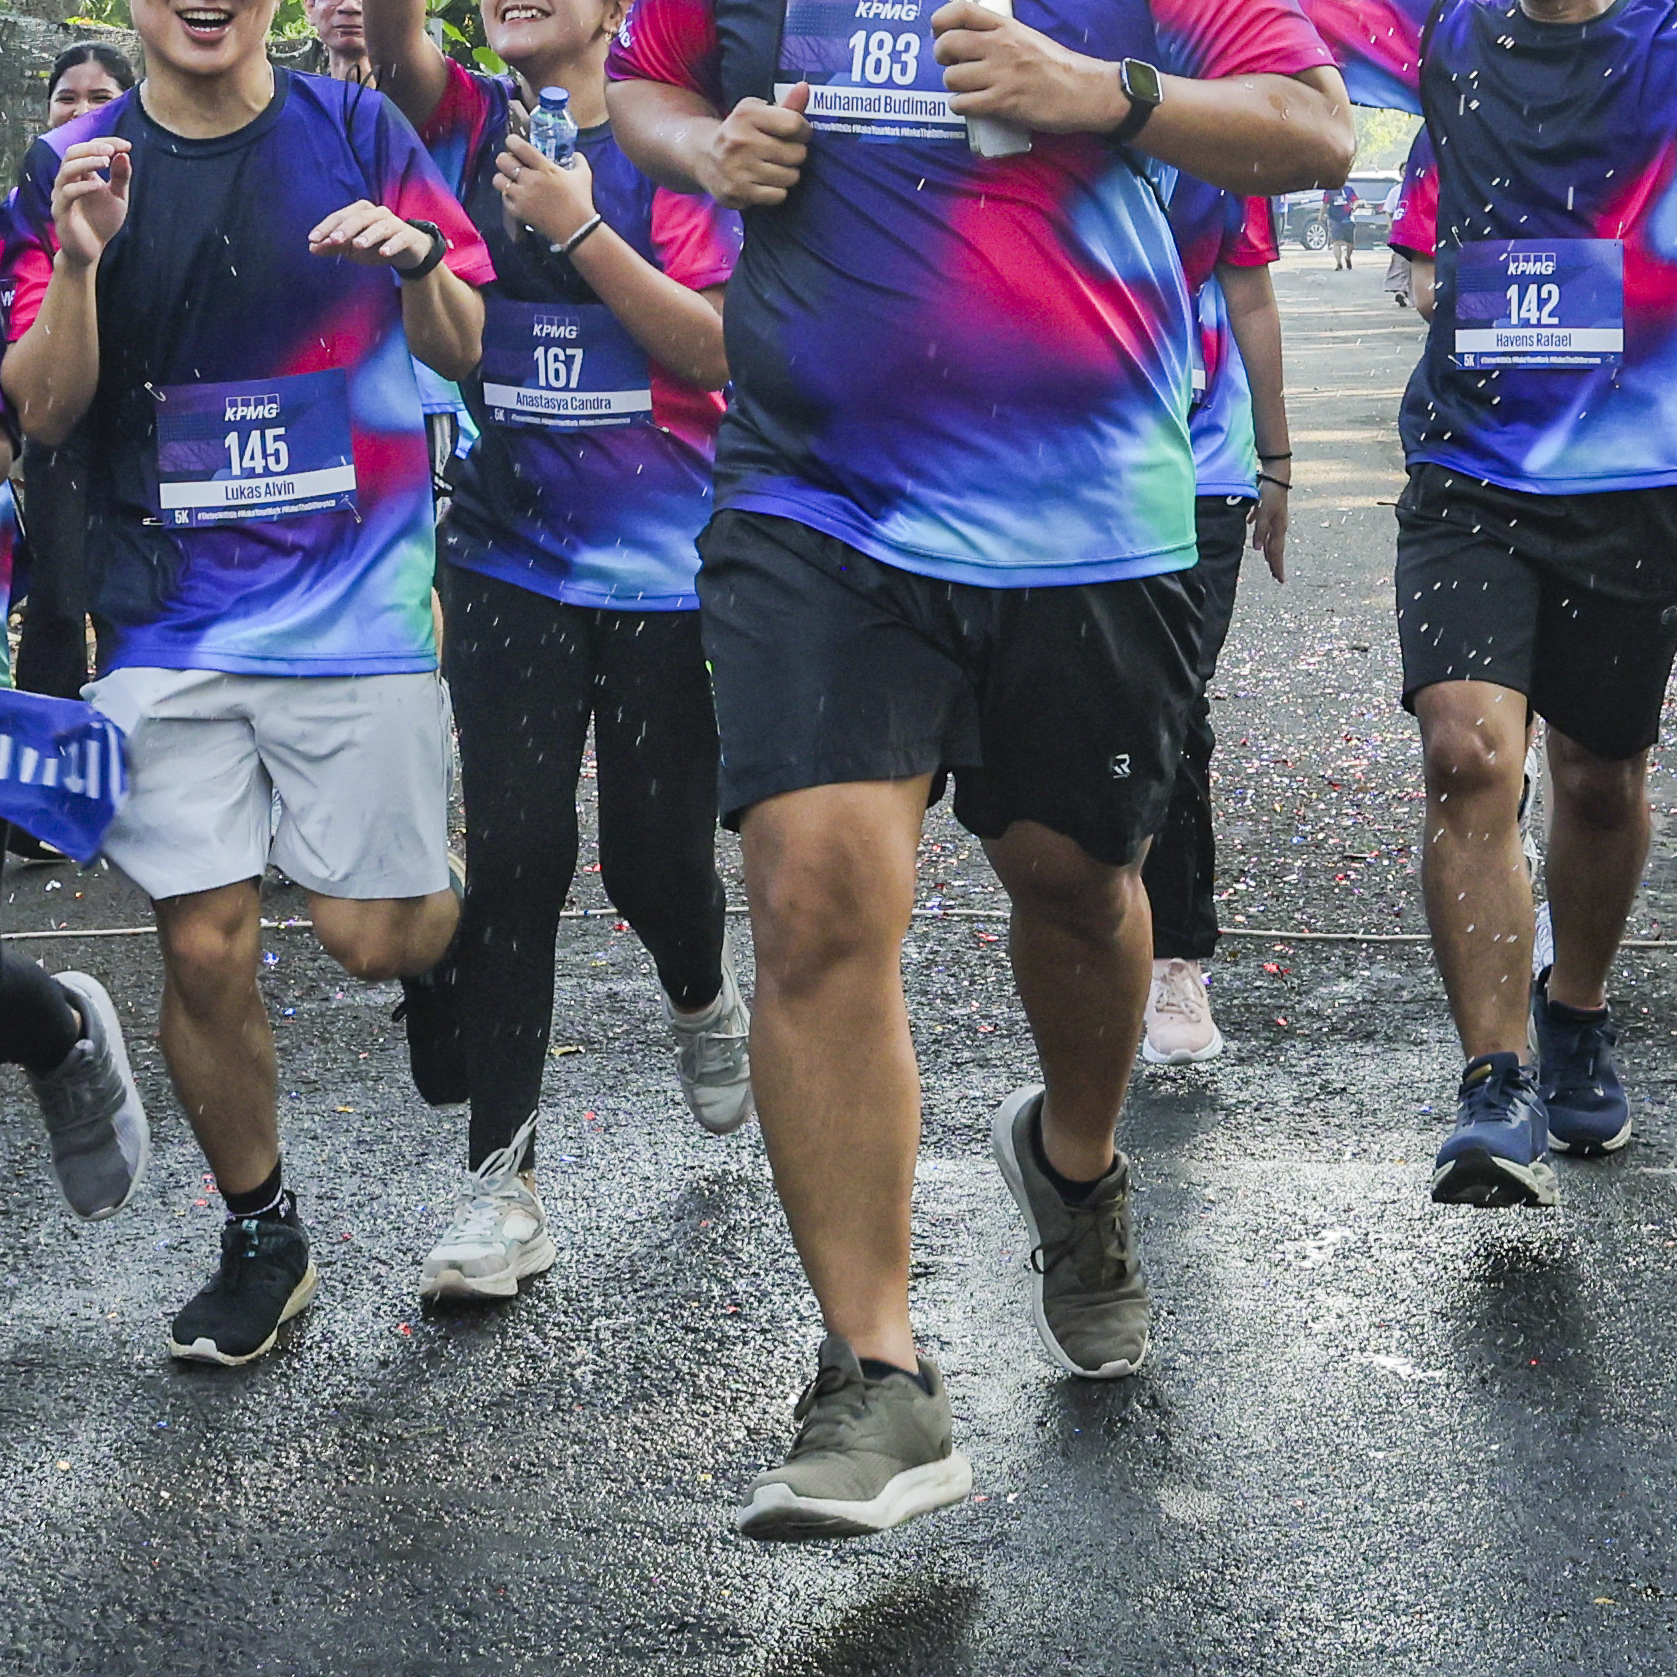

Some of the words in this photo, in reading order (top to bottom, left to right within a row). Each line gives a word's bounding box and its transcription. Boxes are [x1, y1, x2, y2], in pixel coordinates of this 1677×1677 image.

[854, 0, 919, 22] KPMG
[848, 29, 921, 86] 183
[813, 90, 882, 114] Muhamad
[883, 95, 947, 118] Budiman
[1506, 261, 1556, 276] KPMG
[1506, 283, 1561, 326] 142
[532, 323, 579, 340] KPMG
[1495, 333, 1535, 349] Havens
[1535, 332, 1573, 348] Rafael
[532, 345, 585, 389] 167
[1463, 354, 1475, 367] 5K
[515, 391, 570, 412] Anastasya
[570, 395, 612, 411] Candra
[224, 403, 279, 422] KPMG
[223, 426, 290, 476] 145
[224, 483, 263, 501] Lukas
[263, 480, 296, 498] Alvin
[174, 510, 190, 525] 5K
